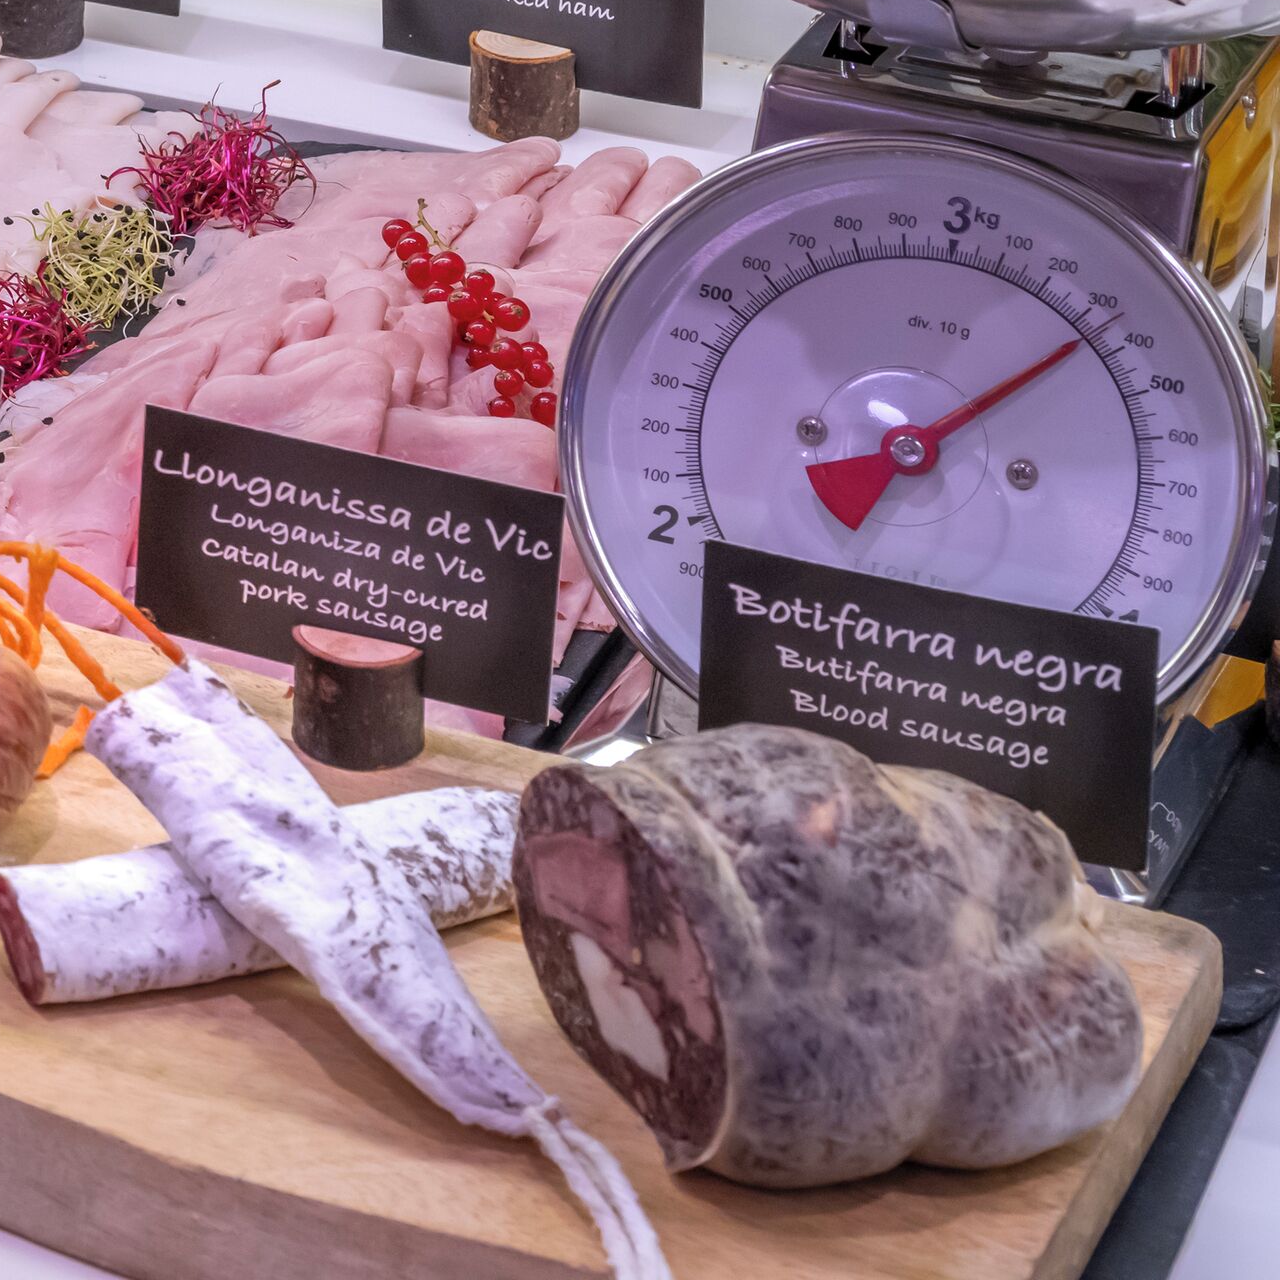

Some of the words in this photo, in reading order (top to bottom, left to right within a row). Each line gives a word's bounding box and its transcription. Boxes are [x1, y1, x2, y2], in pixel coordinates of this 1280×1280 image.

[833, 214, 863, 233] 800
[887, 211, 918, 229] 900
[942, 196, 972, 235] 3
[973, 206, 1001, 231] kg
[788, 231, 817, 250] 700
[1005, 234, 1034, 252] 100
[741, 255, 772, 273] 600
[1047, 256, 1079, 275] 200
[698, 283, 733, 303] 500
[1087, 291, 1119, 310] 300
[669, 326, 699, 344] 400
[907, 314, 933, 330] div.
[940, 320, 958, 336] 10
[960, 327, 971, 341] g
[1123, 331, 1155, 350] 400
[650, 372, 680, 390] 300
[1149, 374, 1185, 395] 500
[640, 417, 671, 435] 200
[1168, 428, 1199, 447] 600
[643, 467, 671, 484] 100
[1168, 479, 1198, 499] 700
[153, 448, 411, 531] Llonganissa
[426, 510, 471, 545] de
[484, 518, 553, 561] Vic
[647, 504, 679, 545] 2
[210, 504, 380, 560] Longaniza
[391, 545, 426, 571] de
[435, 551, 486, 583] Vic
[1162, 528, 1194, 548] 800
[201, 538, 324, 581] Catalan
[333, 568, 488, 621] dry-cured
[1142, 575, 1174, 594] 900
[239, 579, 309, 611] pork
[317, 597, 443, 644] sausage
[728, 582, 954, 661] Botifarra
[974, 643, 1122, 693] negra
[775, 644, 947, 701] Butifarra
[960, 690, 1067, 727] negra
[789, 688, 889, 731] Blood
[899, 719, 1049, 769] sausage
